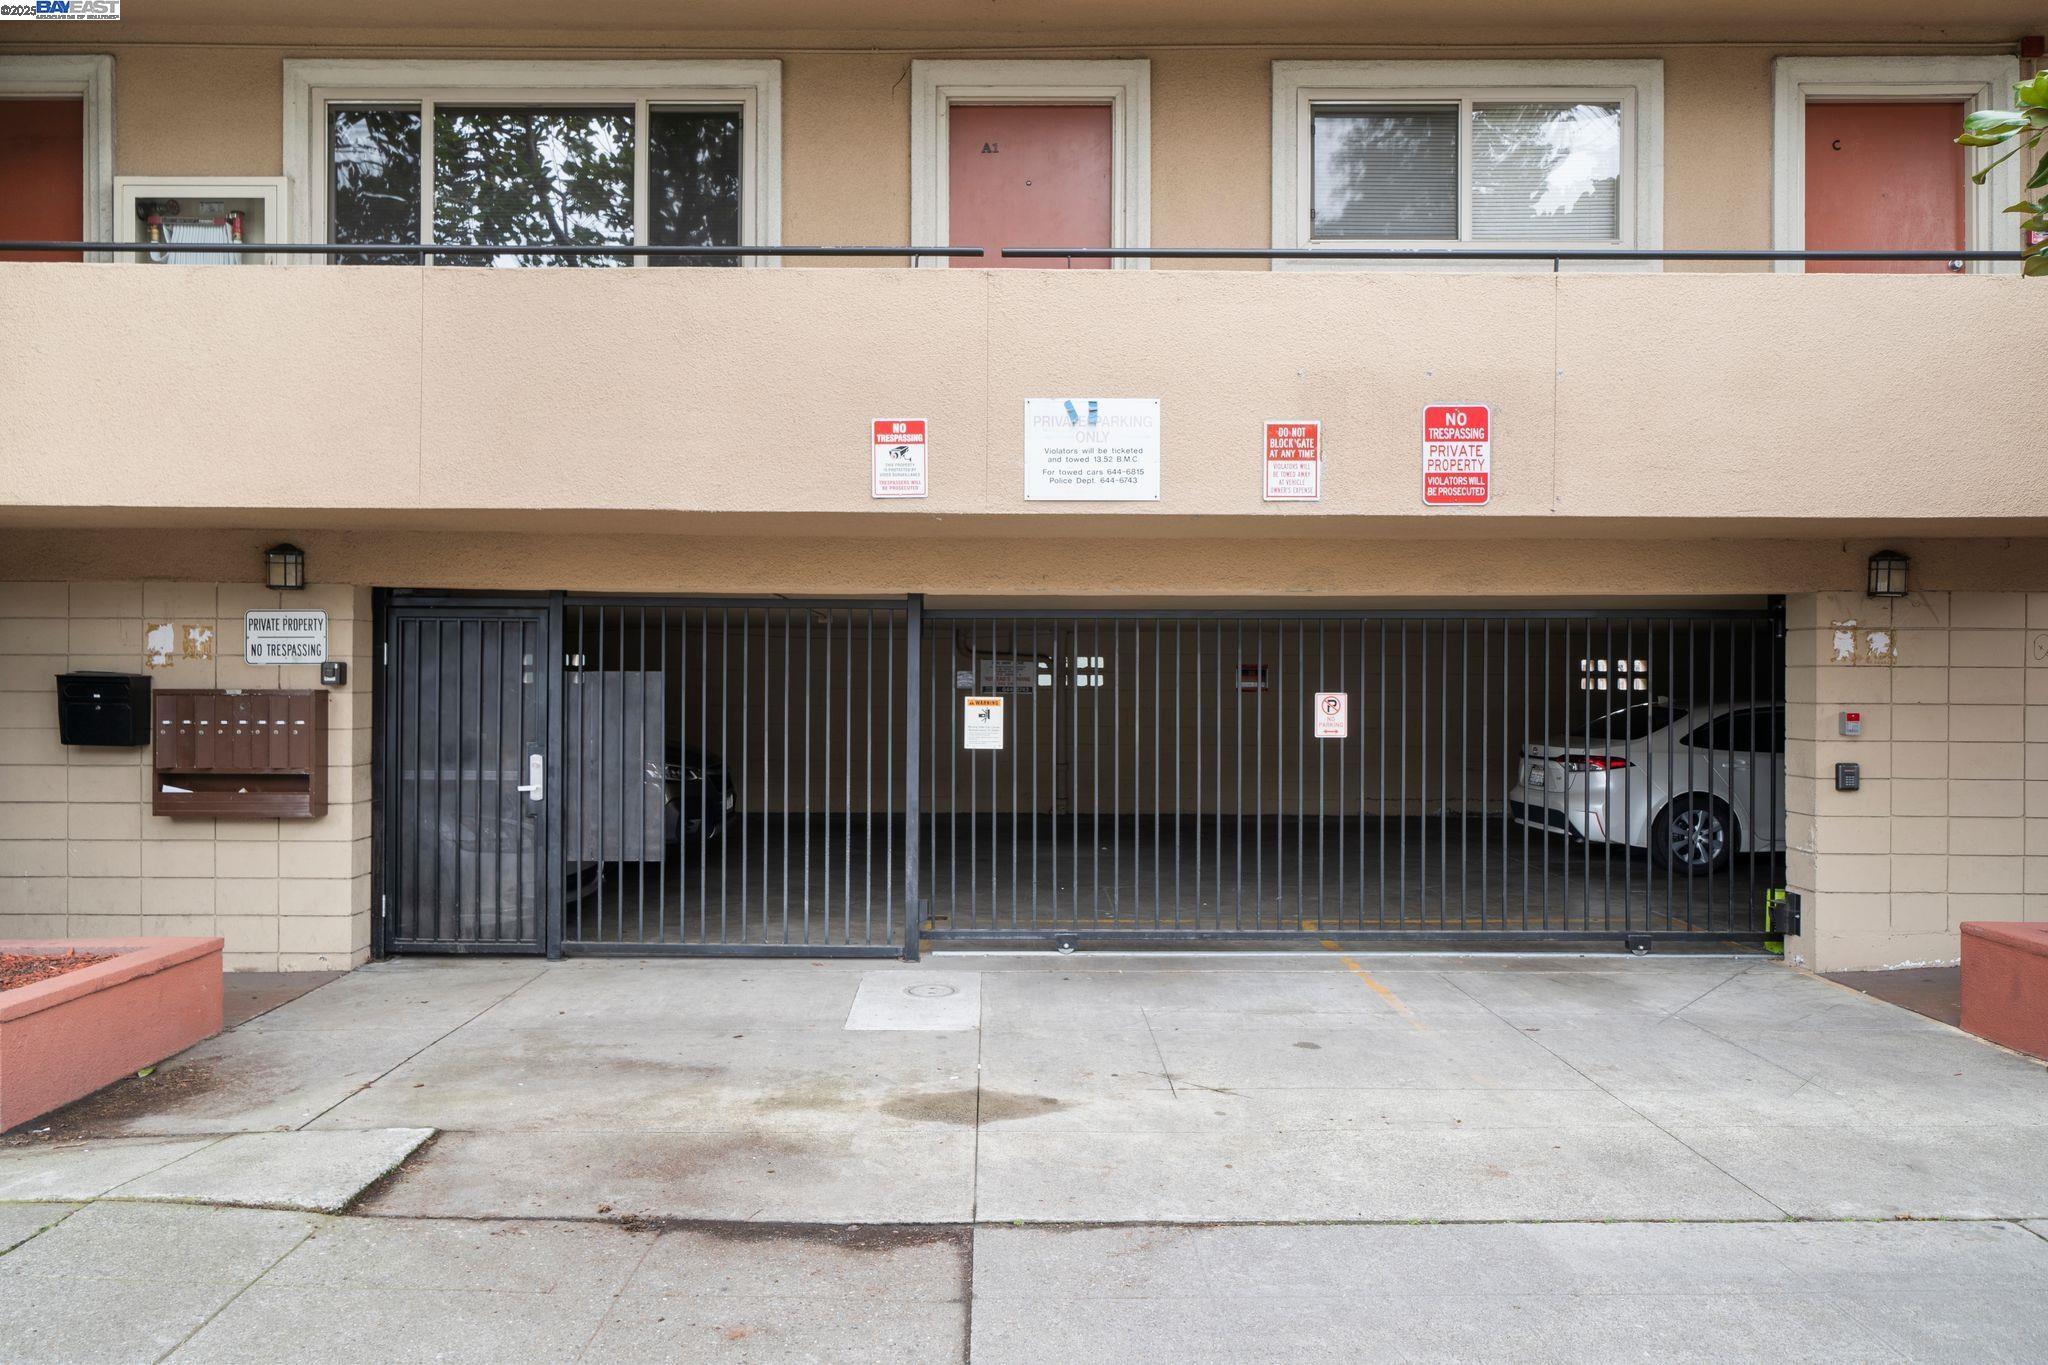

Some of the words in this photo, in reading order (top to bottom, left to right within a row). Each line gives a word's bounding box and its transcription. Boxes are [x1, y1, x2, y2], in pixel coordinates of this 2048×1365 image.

[981, 142, 999, 153] A1
[1832, 140, 1842, 151] C
[1033, 416, 1086, 427] PRIVAE
[1445, 412, 1467, 426] NO
[892, 423, 907, 433] NO
[1278, 428, 1289, 437] DO
[1291, 428, 1306, 437] NOT
[1428, 428, 1485, 439] TRESPASSING
[876, 434, 923, 443] TRESPASSING
[1075, 431, 1110, 443] ONLY
[1270, 438, 1294, 448] BLOCK
[1296, 438, 1314, 448] GATE
[1269, 450, 1278, 458] AT
[1280, 450, 1296, 458] ANY
[1298, 450, 1315, 458] TIME
[1429, 445, 1483, 457] PRIVATE
[1427, 459, 1485, 471] PROPERTY
[1050, 477, 1072, 485] Police
[1427, 476, 1468, 485] VIOLATORS
[1469, 476, 1485, 485] WILL
[1427, 487, 1437, 496] BE
[1438, 487, 1485, 496] PROSECUTED
[248, 618, 280, 631] PRIVATE
[282, 618, 323, 631] PROPERTY
[251, 644, 262, 656] NO
[267, 644, 322, 656] TRESPASSING
